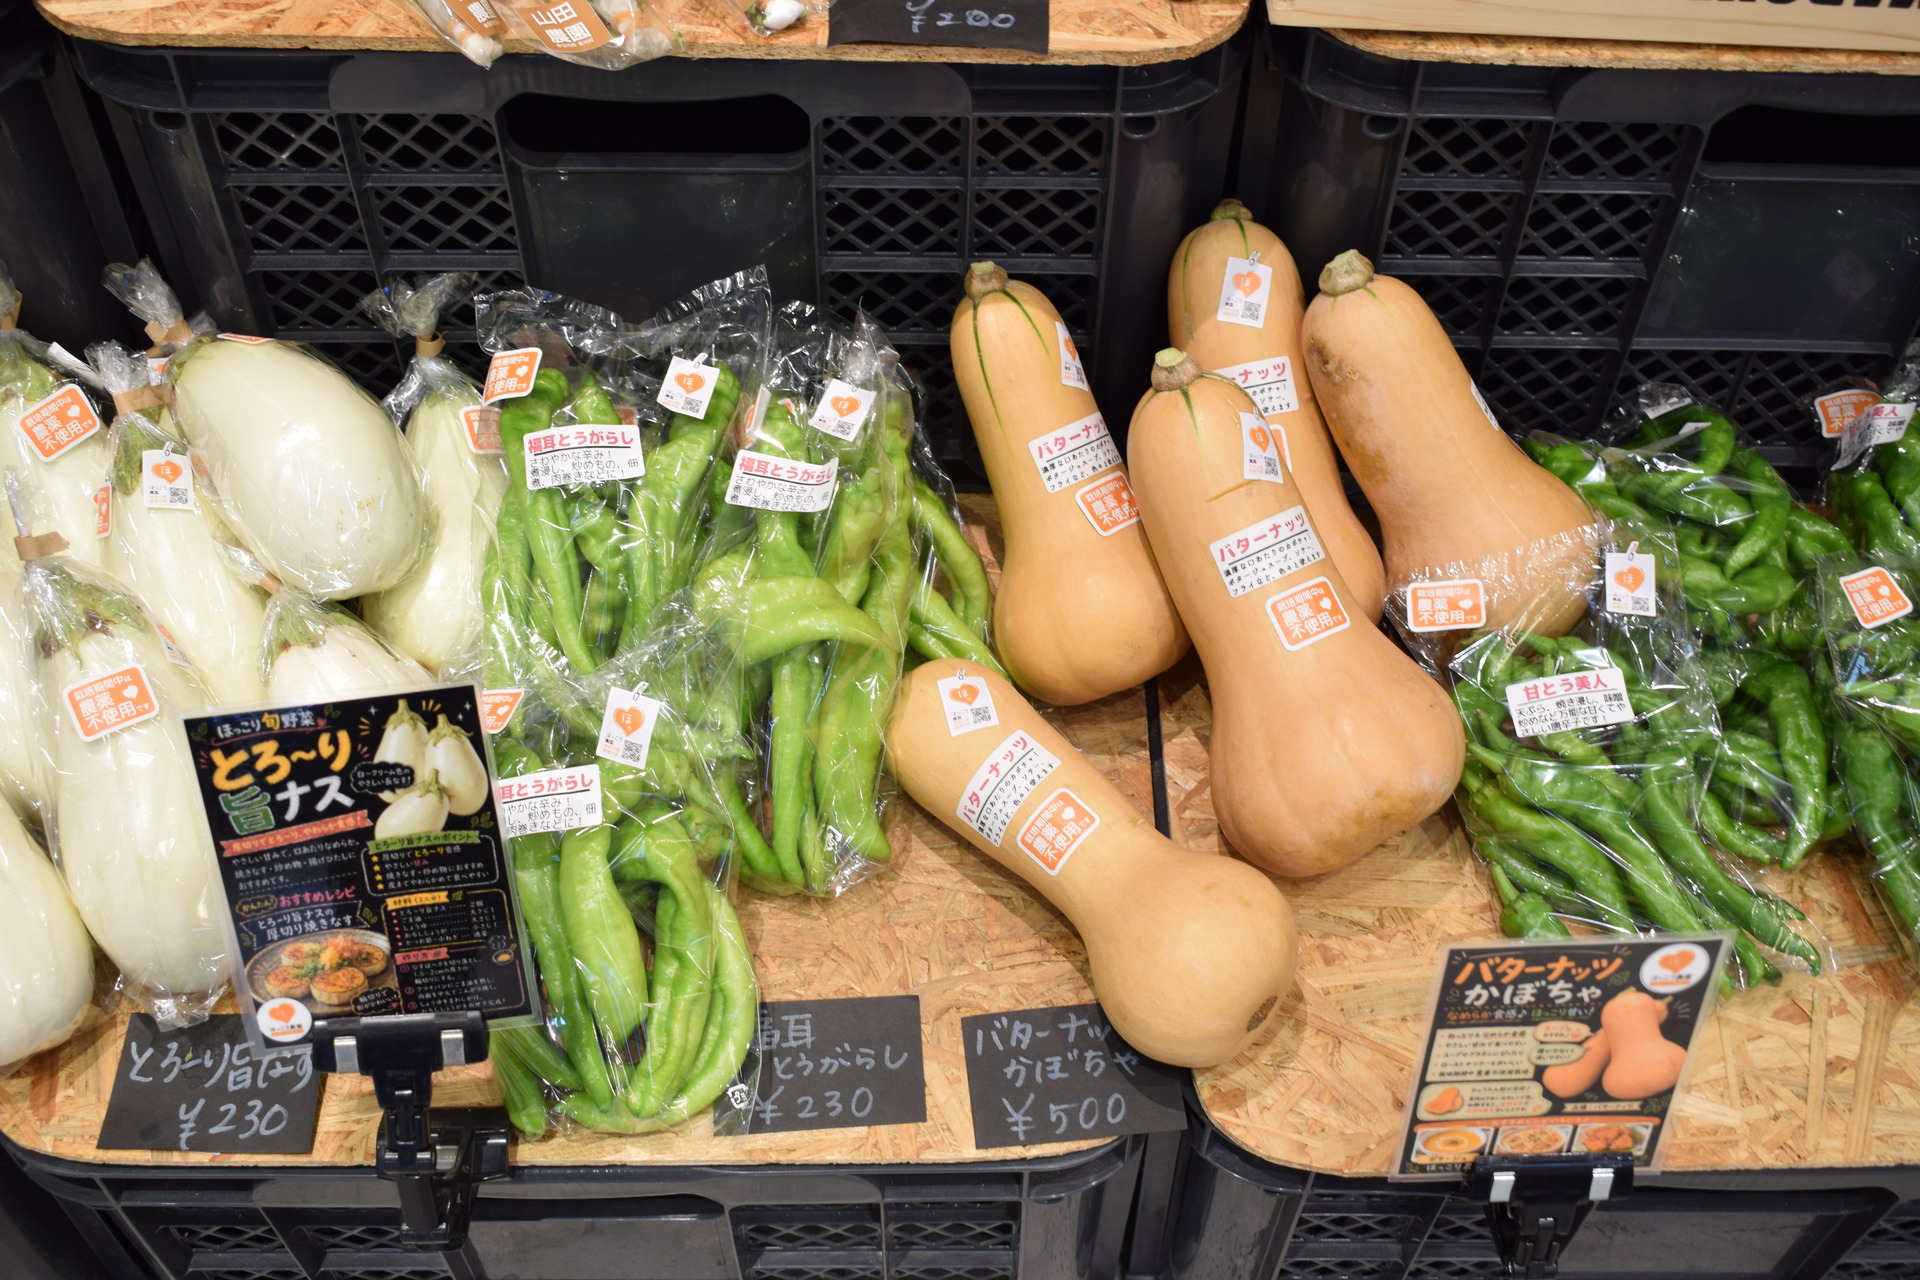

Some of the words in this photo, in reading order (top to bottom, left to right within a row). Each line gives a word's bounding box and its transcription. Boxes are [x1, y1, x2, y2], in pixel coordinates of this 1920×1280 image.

[531, 1, 578, 26] 山田
[544, 21, 592, 43] 農園
[24, 396, 72, 427] 栽培期間中は
[31, 415, 64, 441] 農薬
[41, 418, 93, 451] 不使用です
[528, 430, 634, 453] 福耳とうがらし
[529, 449, 612, 467] さわやかな辛み！
[738, 456, 834, 483] 福耳とうがらし
[1091, 494, 1119, 516] 農薬
[1219, 513, 1305, 562] バターナッツ
[1276, 587, 1325, 612] 栽培期間中は
[1416, 587, 1471, 598] 栽培期間中は
[1417, 597, 1449, 612] 農薬
[1281, 603, 1315, 628] 農薬
[1289, 611, 1343, 640] 不使用です
[1418, 609, 1479, 626] 不使用です
[73, 675, 132, 700] 栽培期間中は
[1523, 674, 1608, 701] 甘とう美人
[79, 691, 115, 717] 農薬
[84, 700, 150, 730] 不使用です
[216, 710, 316, 739] ほっこり旬野菜
[963, 736, 1028, 823] バターナッツ
[218, 774, 355, 835] 旨ナス
[1025, 799, 1065, 844] 栽培期間中は
[1033, 823, 1060, 855] 農薬
[1045, 817, 1092, 863] 不使用です
[238, 875, 289, 891] おすすめです。
[279, 885, 356, 908] おすすめレシピ
[267, 914, 353, 941] 厚切り焼きなす
[1454, 955, 1623, 985] バターナッツ
[1463, 979, 1602, 1006] かぼちゃ
[773, 1042, 909, 1080] とうがらし
[1003, 1048, 1140, 1087] かぼちゃ
[754, 1085, 874, 1125] ¥230
[1001, 1092, 1126, 1141] ¥500
[179, 1098, 288, 1151] ¥230
